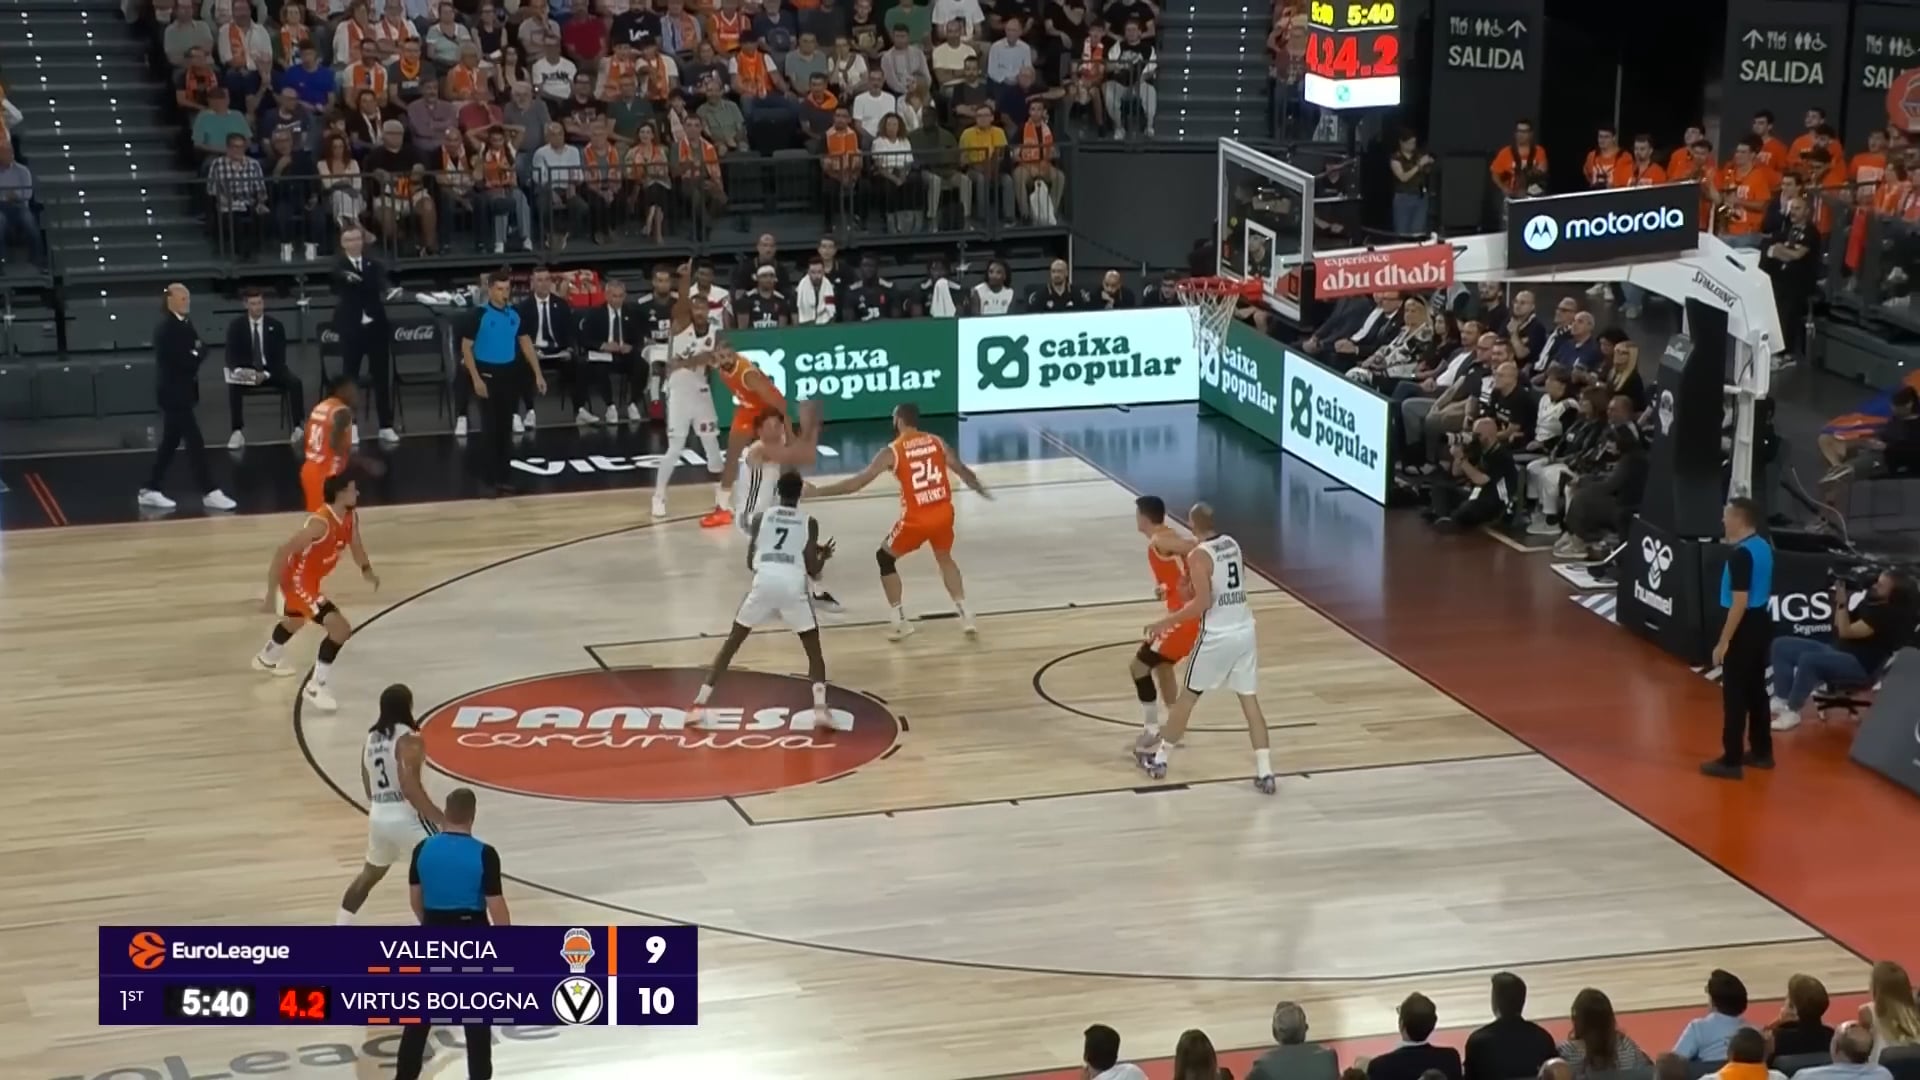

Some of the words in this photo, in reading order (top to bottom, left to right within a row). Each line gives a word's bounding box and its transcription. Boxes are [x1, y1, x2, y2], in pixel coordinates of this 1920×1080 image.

[1347, 3, 1395, 26] 5:40
[1333, 34, 1399, 78] 4.2
[1448, 45, 1524, 70] SALIDA
[1740, 59, 1824, 85] SALIDA
[1565, 206, 1684, 240] motorola
[1322, 267, 1370, 291] abu
[1374, 259, 1447, 287] dhabi
[1324, 253, 1390, 266] experience
[797, 344, 889, 372] caixa
[1039, 332, 1130, 358] caixa
[1039, 353, 1182, 388] popular
[1222, 346, 1258, 380] caixa
[795, 365, 941, 401] popular
[1221, 370, 1277, 415] popular
[1316, 396, 1355, 433] caixa
[1316, 420, 1378, 470] popular
[909, 458, 943, 490] 24
[773, 527, 789, 550] 7
[1227, 562, 1240, 589] 9
[1634, 579, 1673, 616] hummel
[1793, 623, 1832, 636] Seguros
[451, 706, 854, 731] PAMESA
[375, 757, 390, 788] 3
